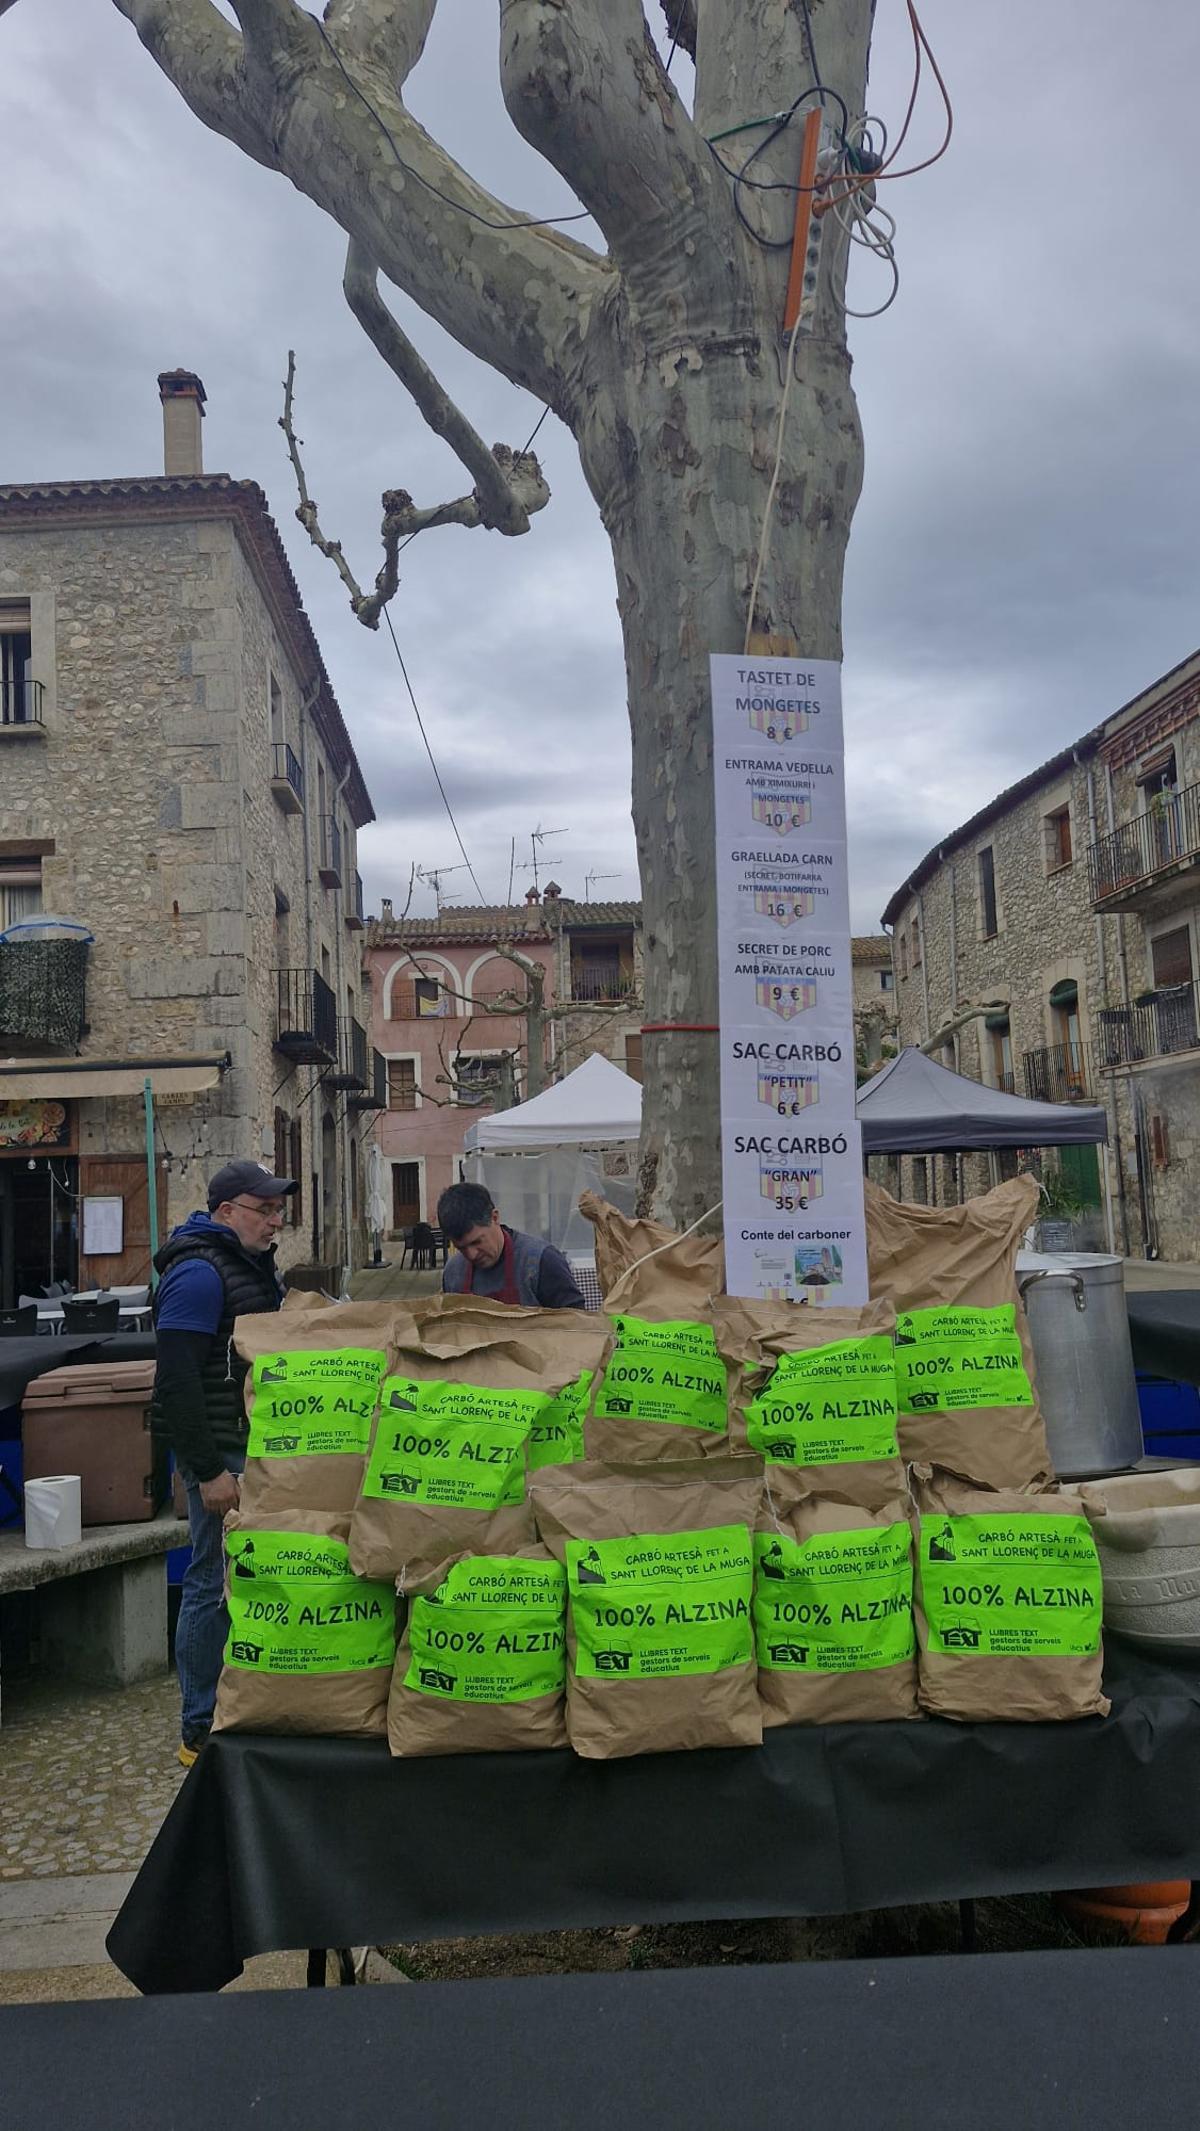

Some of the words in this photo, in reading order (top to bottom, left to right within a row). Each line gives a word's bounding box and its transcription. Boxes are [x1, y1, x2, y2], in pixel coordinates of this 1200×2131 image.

[737, 671, 791, 685] TASTET
[797, 674, 815, 686] DE
[736, 698, 820, 713] MONGETES
[767, 727, 775, 739] 8
[784, 728, 792, 740] €
[726, 760, 782, 772] ENTRAMA
[786, 763, 833, 774] VEDELLA
[758, 794, 804, 804] MONGETES
[766, 814, 782, 826] 10
[791, 815, 800, 827] €
[732, 851, 799, 864] GRAELLADA
[802, 854, 832, 865] CARN
[780, 873, 822, 881] BOTIFARRA
[768, 904, 784, 916] 16
[794, 905, 803, 917] €
[738, 944, 779, 954] SECRET
[783, 945, 797, 955] DE
[801, 946, 831, 956] PORC
[735, 965, 759, 974] AMB
[763, 966, 802, 976] PATATA
[806, 967, 834, 976] CALIU
[773, 988, 781, 1000] 9
[791, 988, 799, 1000] €
[733, 1043, 770, 1059] SAC
[776, 1042, 841, 1062] CARBÓ
[777, 1102, 786, 1115] 6
[792, 1103, 800, 1115] €
[735, 1137, 772, 1153] SAC
[778, 1134, 847, 1154] CARBÓ
[776, 1197, 793, 1210] 35
[799, 1197, 808, 1210] €
[741, 1230, 774, 1240] Conte
[778, 1230, 794, 1240] del
[797, 1230, 851, 1239] carboner
[644, 1331, 671, 1339] CARBÓ
[674, 1333, 703, 1343] ARTESÀ
[920, 1330, 940, 1339] SANT
[629, 1338, 649, 1346] SANT
[652, 1341, 686, 1354] LLORENÇ
[310, 1357, 343, 1366] CARBÓ
[346, 1360, 380, 1372] ARTESÀ
[801, 1366, 842, 1377] LLORENÇ
[908, 1357, 954, 1377] 100%
[962, 1355, 1018, 1370] ALZINA
[321, 1369, 361, 1380] LLORENÇ
[365, 1374, 375, 1382] DE
[611, 1367, 654, 1383] 100%
[662, 1371, 722, 1396] ALZINA
[272, 1395, 324, 1417] 100%
[441, 1394, 474, 1404] CARBÓ
[478, 1397, 518, 1408] ARTESÀ
[422, 1405, 446, 1413] SANT
[451, 1406, 493, 1419] LLORENÇ
[498, 1411, 511, 1419] DE
[515, 1414, 527, 1423] LA
[762, 1403, 813, 1426] 100%
[823, 1399, 895, 1419] ALZINA
[392, 1433, 452, 1458] 100%
[428, 1487, 452, 1495] gestors
[458, 1480, 477, 1488] TEXT
[427, 1494, 464, 1502] educatius
[979, 1529, 1014, 1542] CARBÓ
[1019, 1530, 1060, 1543] ARTESÀ
[277, 1549, 312, 1560] CARBÓ
[626, 1548, 662, 1565] CARBÓ
[665, 1547, 702, 1561] ARTESÀ
[706, 1549, 719, 1557] FET
[805, 1547, 838, 1561] CARBÓ
[843, 1543, 879, 1557] ARTESÀ
[993, 1548, 1039, 1559] LLORENÇ
[1043, 1549, 1053, 1557] DE
[1058, 1550, 1069, 1558] LA
[1073, 1548, 1096, 1558] MUGA
[260, 1566, 282, 1574] SANT
[611, 1571, 637, 1580] SANT
[641, 1566, 683, 1578] LLORENÇ
[686, 1565, 700, 1574] DE
[703, 1563, 716, 1572] LA
[720, 1557, 750, 1569] MUGA
[790, 1567, 815, 1576] SANT
[820, 1564, 861, 1575] LLORENÇ
[866, 1562, 876, 1570] DE
[879, 1561, 889, 1569] LA
[469, 1574, 505, 1587] CARBÓ
[510, 1574, 549, 1587] ARTESÀ
[453, 1593, 477, 1602] SANT
[481, 1593, 527, 1605] LLORENÇ
[532, 1593, 544, 1602] DE
[548, 1595, 557, 1603] LA
[943, 1585, 1004, 1606] 100%
[1015, 1587, 1093, 1607] ALZINA
[244, 1601, 290, 1625] 100%
[299, 1600, 382, 1625] ALZINA
[595, 1604, 655, 1627] 100%
[666, 1598, 747, 1624] ALZINA
[774, 1604, 832, 1625] 100%
[841, 1593, 910, 1623] ALZINA
[426, 1629, 485, 1653] 100%
[640, 1657, 669, 1667] gestors
